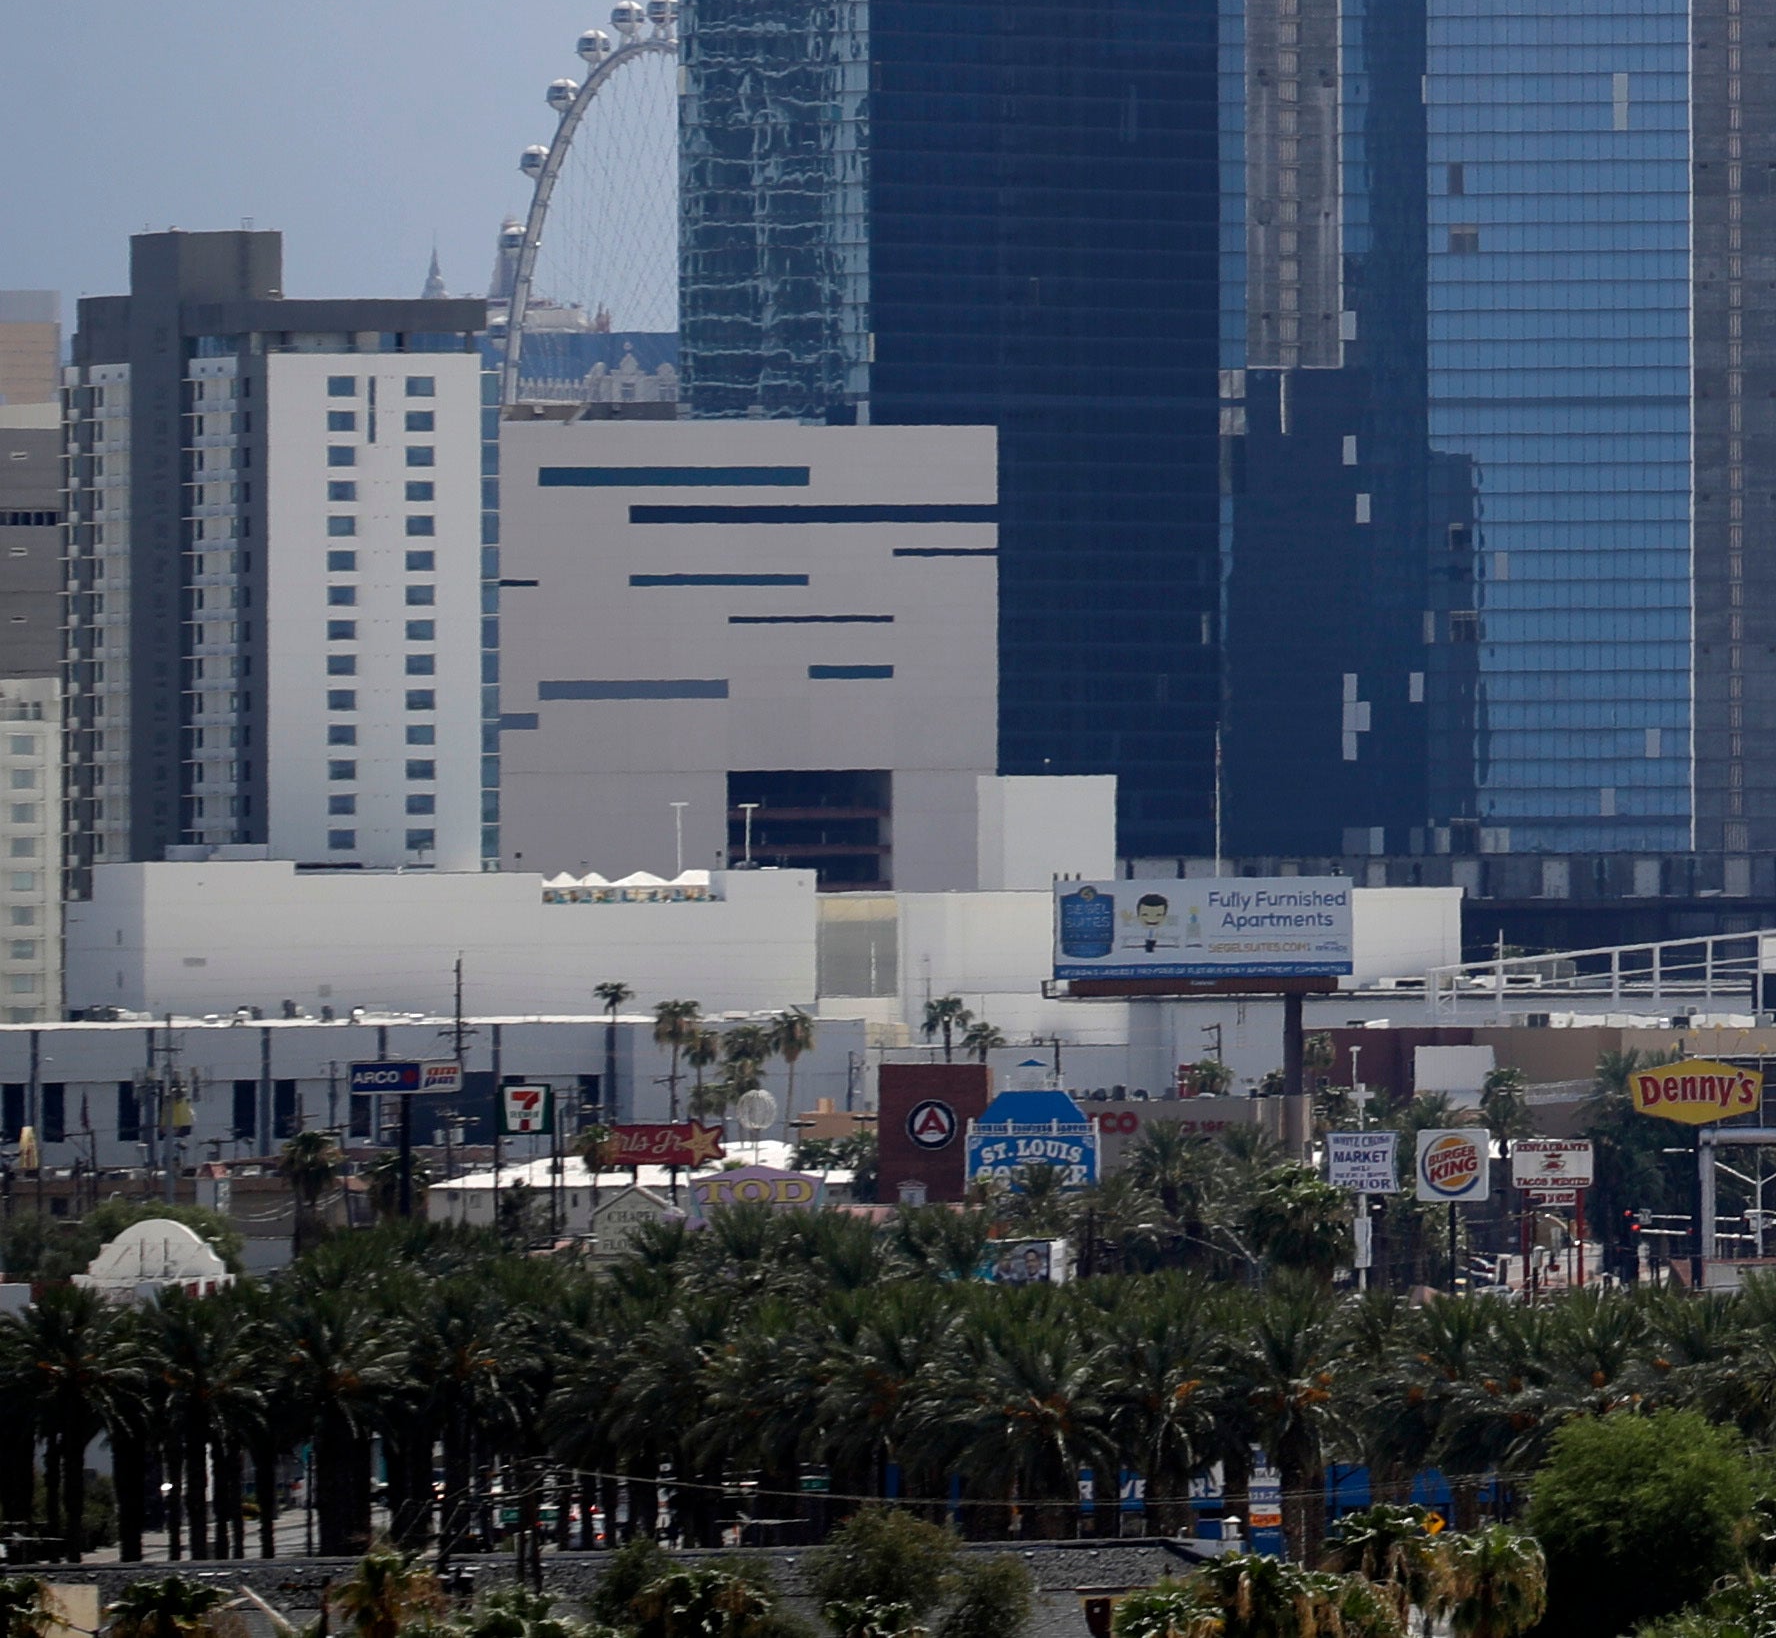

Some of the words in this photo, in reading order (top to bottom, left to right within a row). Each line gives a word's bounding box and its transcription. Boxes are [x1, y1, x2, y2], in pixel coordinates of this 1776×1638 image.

[1209, 891, 1251, 912] Fully
[1255, 891, 1347, 907] Furnished
[1221, 912, 1334, 931] Apartments
[353, 1070, 399, 1084] ARCO
[1638, 1071, 1756, 1108] Denny's
[981, 1142, 1014, 1164] ST.
[1016, 1139, 1083, 1163] LOUIS
[1333, 1150, 1388, 1163] MARKET
[1428, 1144, 1476, 1166] BURGER
[1430, 1156, 1478, 1183] KING
[695, 1179, 814, 1204] TOD
